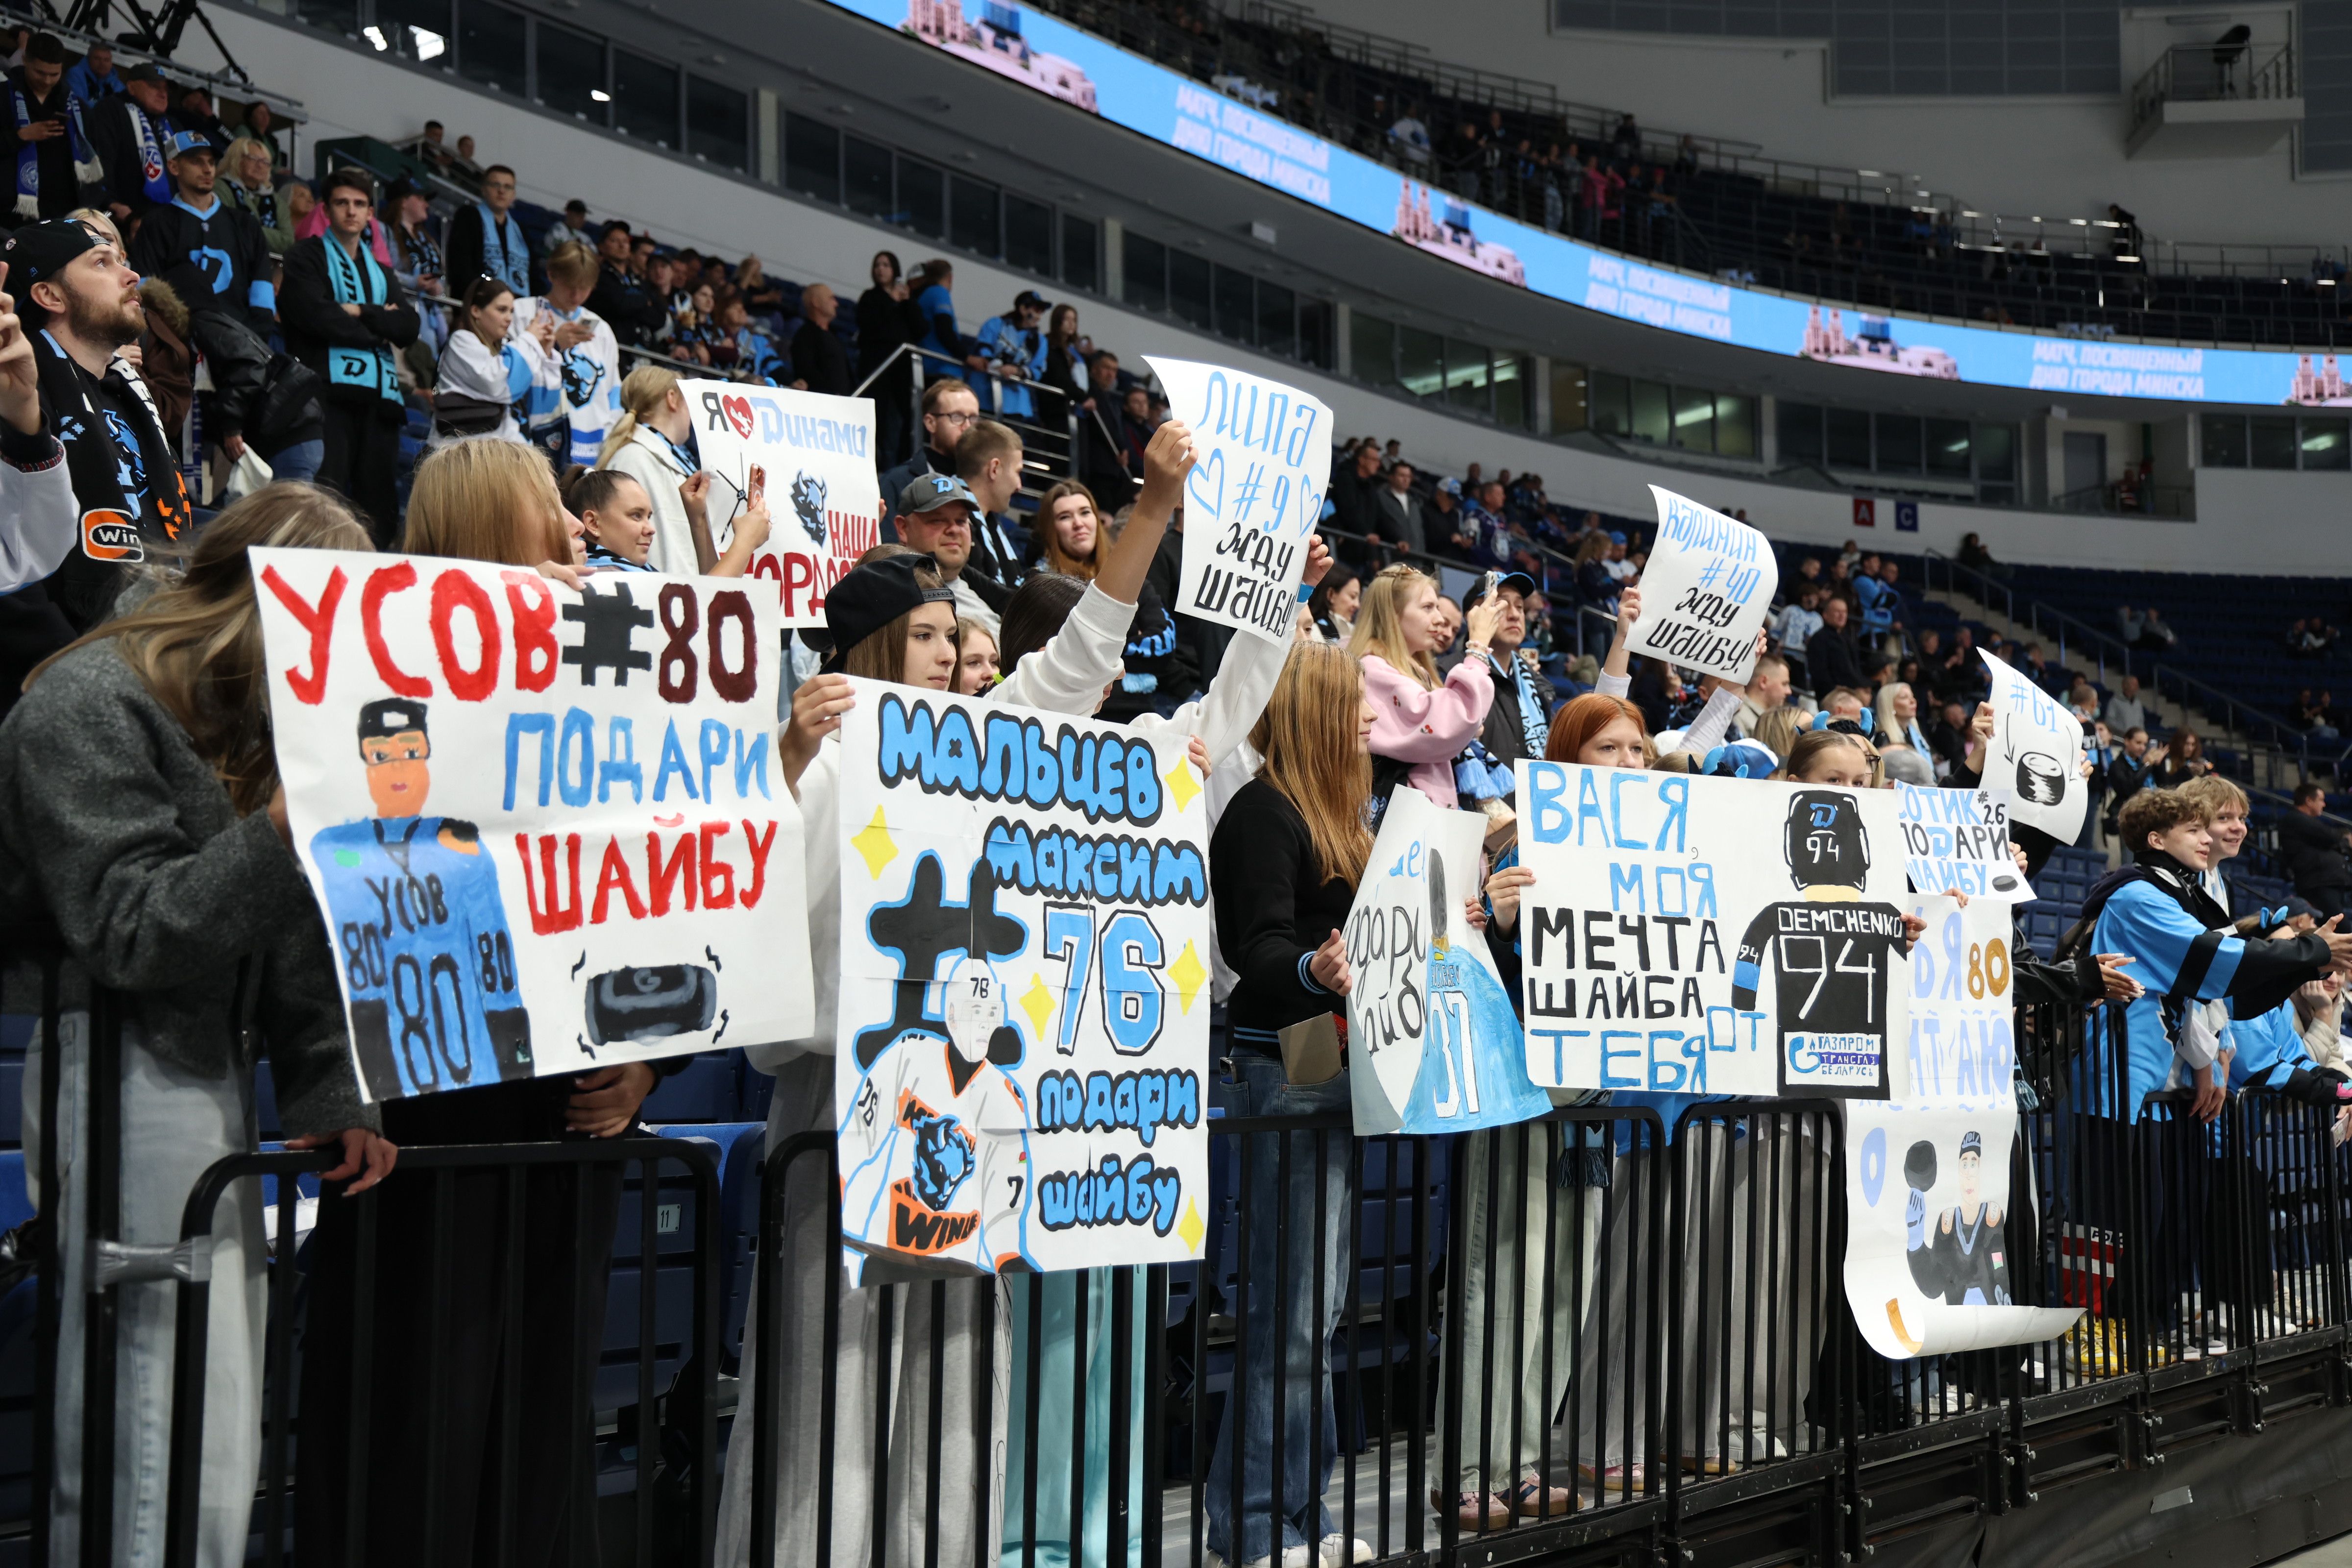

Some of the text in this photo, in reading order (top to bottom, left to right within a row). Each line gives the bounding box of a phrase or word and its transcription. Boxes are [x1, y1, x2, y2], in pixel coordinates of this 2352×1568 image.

[2028, 364, 2205, 399] ДНЮ ГОРОДА МИНСКА
[2033, 340, 2078, 366] МАТЧ,
[702, 392, 729, 432] Я
[261, 560, 758, 706] УСОВ #80
[502, 705, 771, 812] ПОДАРИ
[514, 812, 779, 935] ШАЙБУ
[1807, 836, 1839, 863] 94
[364, 872, 448, 940] УСОВ
[1609, 862, 1717, 918] МОЯ
[1532, 906, 1726, 974] МЕЧТА
[1739, 944, 1759, 965] 94
[1777, 907, 1903, 938] DEMCHENKO
[1909, 906, 2009, 1001] ЬЯ 80
[343, 921, 386, 991] 80
[477, 929, 515, 993] 80
[1044, 901, 1165, 1057] 76
[1343, 905, 1426, 1010] одари
[1780, 934, 1876, 1024] 94
[392, 952, 472, 1094] 80
[1529, 970, 1704, 1019] ШАЙБА
[1706, 1005, 1768, 1052] ОТ
[1818, 1035, 1874, 1052] ГАЗПРОМ
[1822, 1054, 1875, 1065] ТРАНСГАЗ
[1530, 1029, 1707, 1093] ТЕБЯ
[1822, 1065, 1873, 1077] БЕЛАРУСЬ
